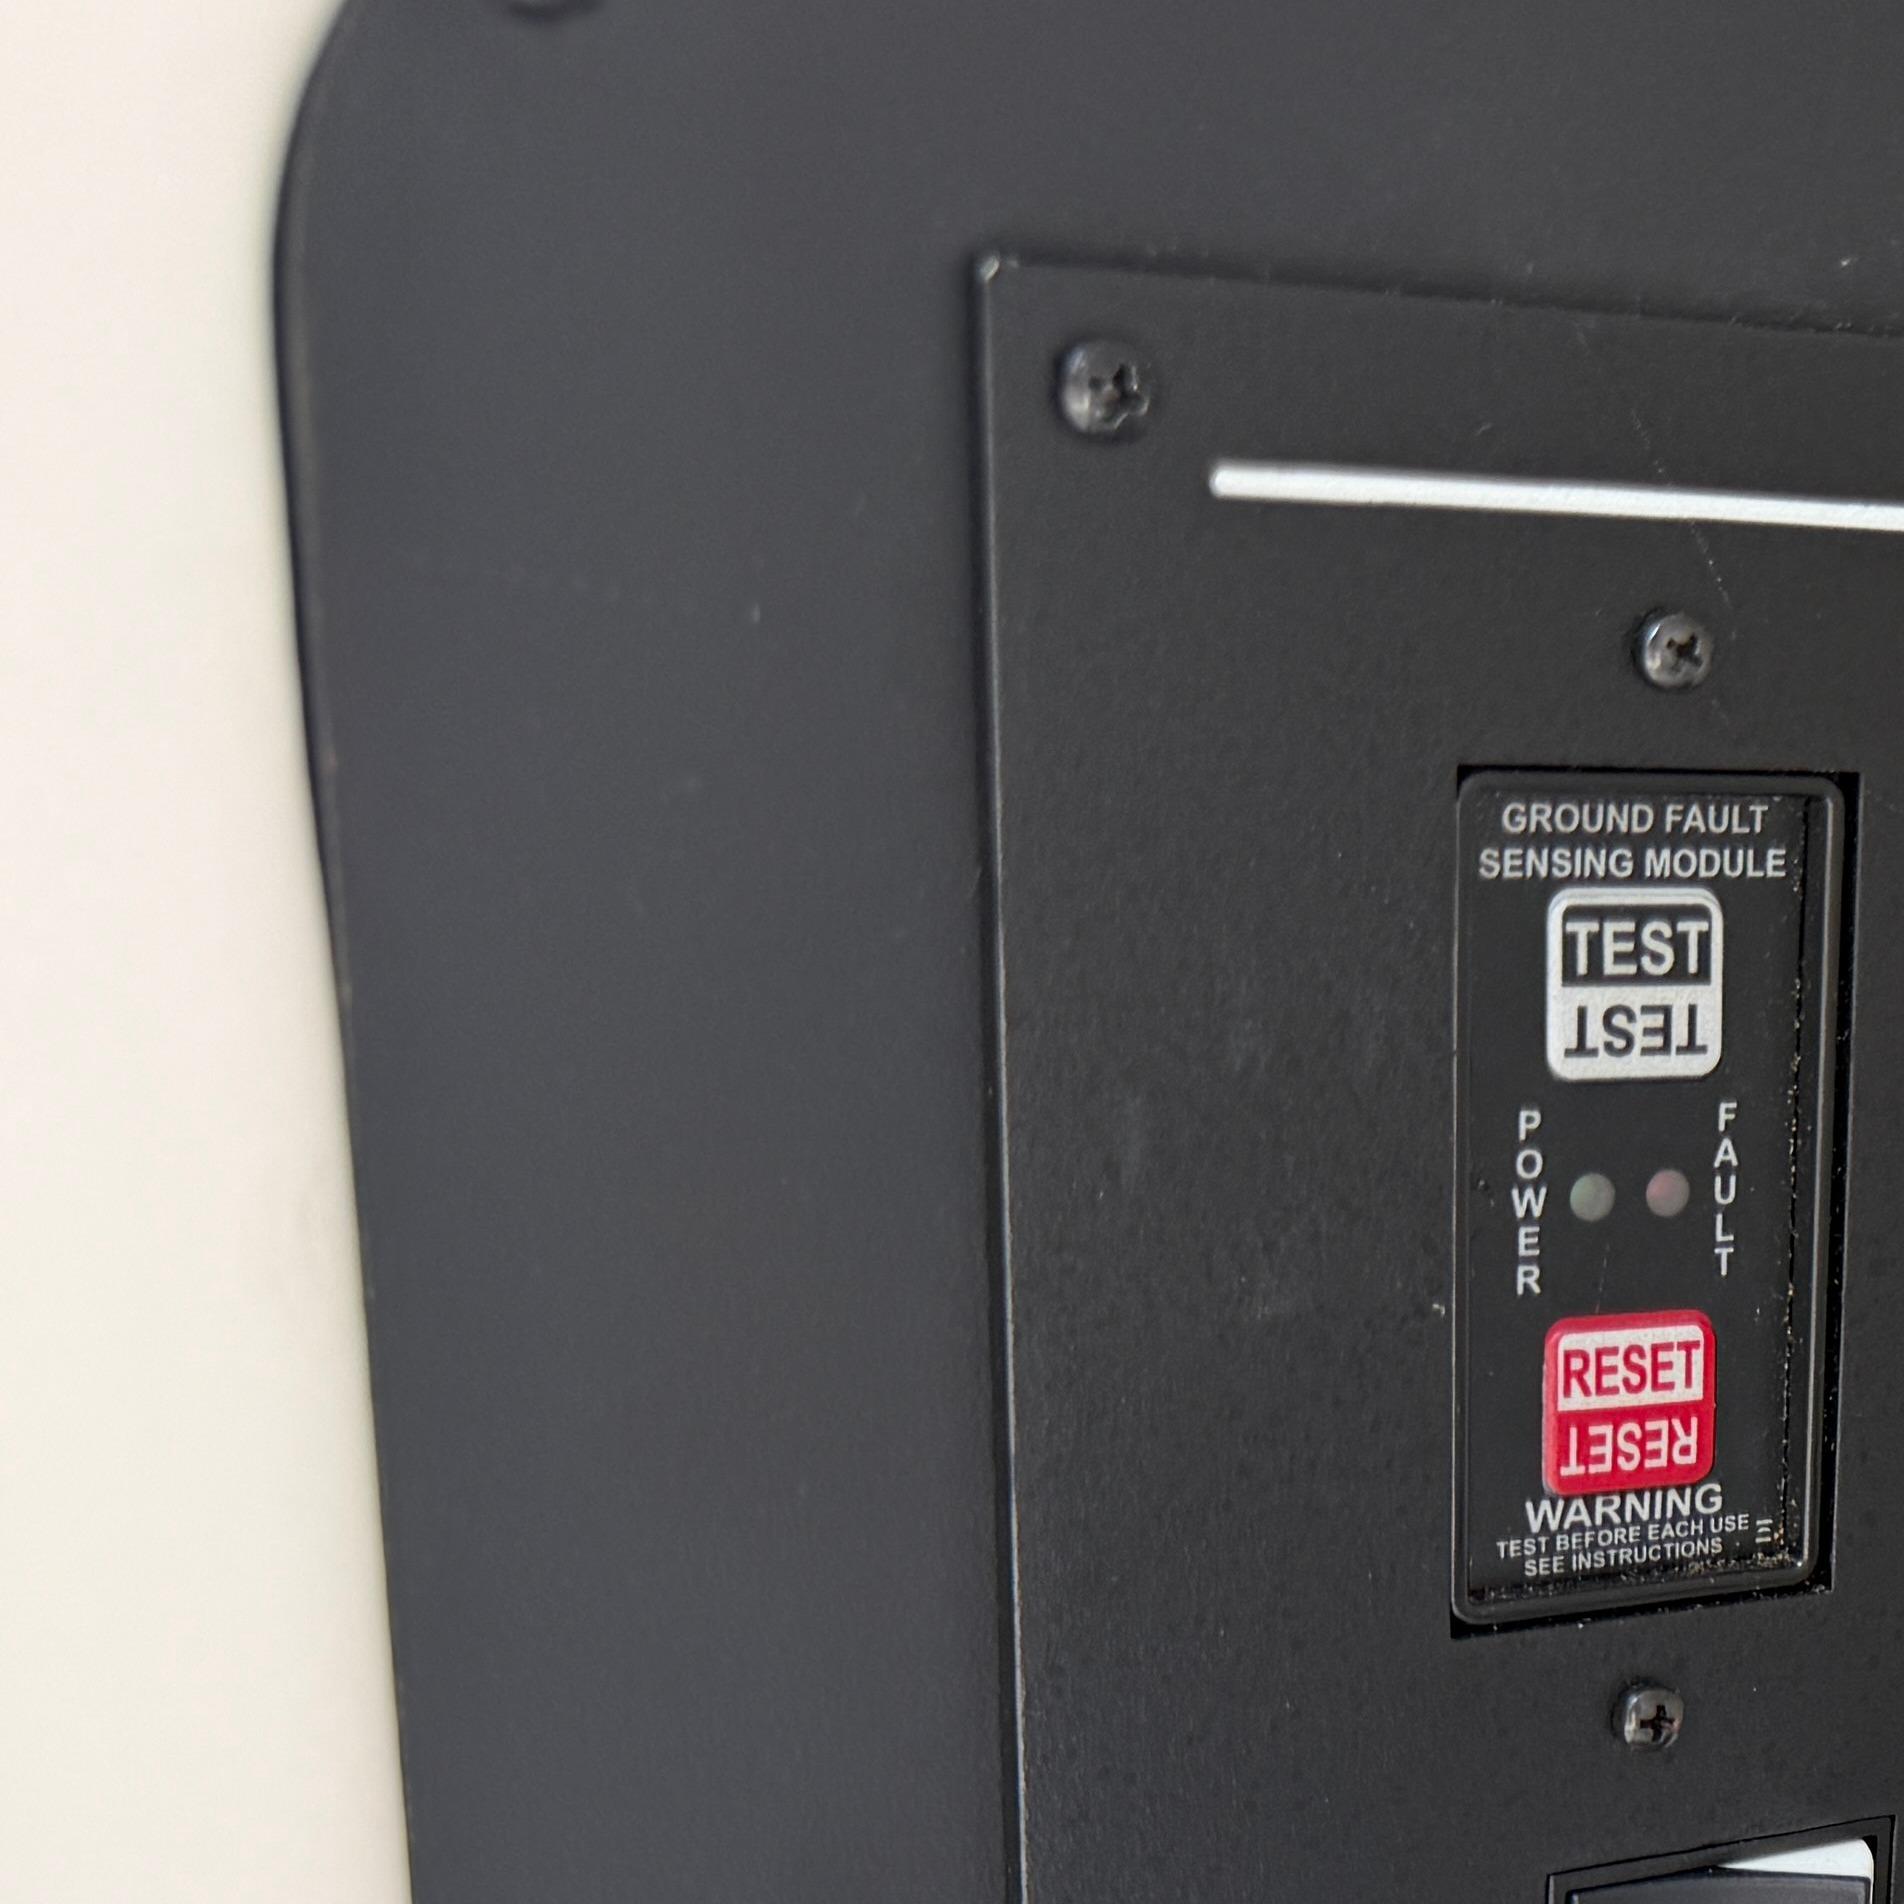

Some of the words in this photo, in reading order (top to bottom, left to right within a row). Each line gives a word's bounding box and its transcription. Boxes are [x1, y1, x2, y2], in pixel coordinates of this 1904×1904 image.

[1501, 802, 1654, 834] GROUND
[1665, 803, 1769, 834] FAULT
[1479, 847, 1634, 879] SENSING
[1644, 847, 1786, 878] MODULE
[1564, 920, 1709, 976] TEST
[1564, 1003, 1708, 1058] TEST
[1511, 1109, 1547, 1296] POWER
[1713, 1101, 1738, 1277] FAULT
[1562, 1339, 1701, 1400] RESET
[1560, 1415, 1699, 1476] RESET
[1524, 1482, 1724, 1534] WARNING
[1496, 1538, 1549, 1560] TEST
[1555, 1525, 1641, 1552] BEFORE
[1647, 1520, 1704, 1541] EACH
[1710, 1513, 1750, 1533] USE
[1524, 1555, 1566, 1577] SEE
[1572, 1537, 1724, 1572] INSTRUCTIONS
